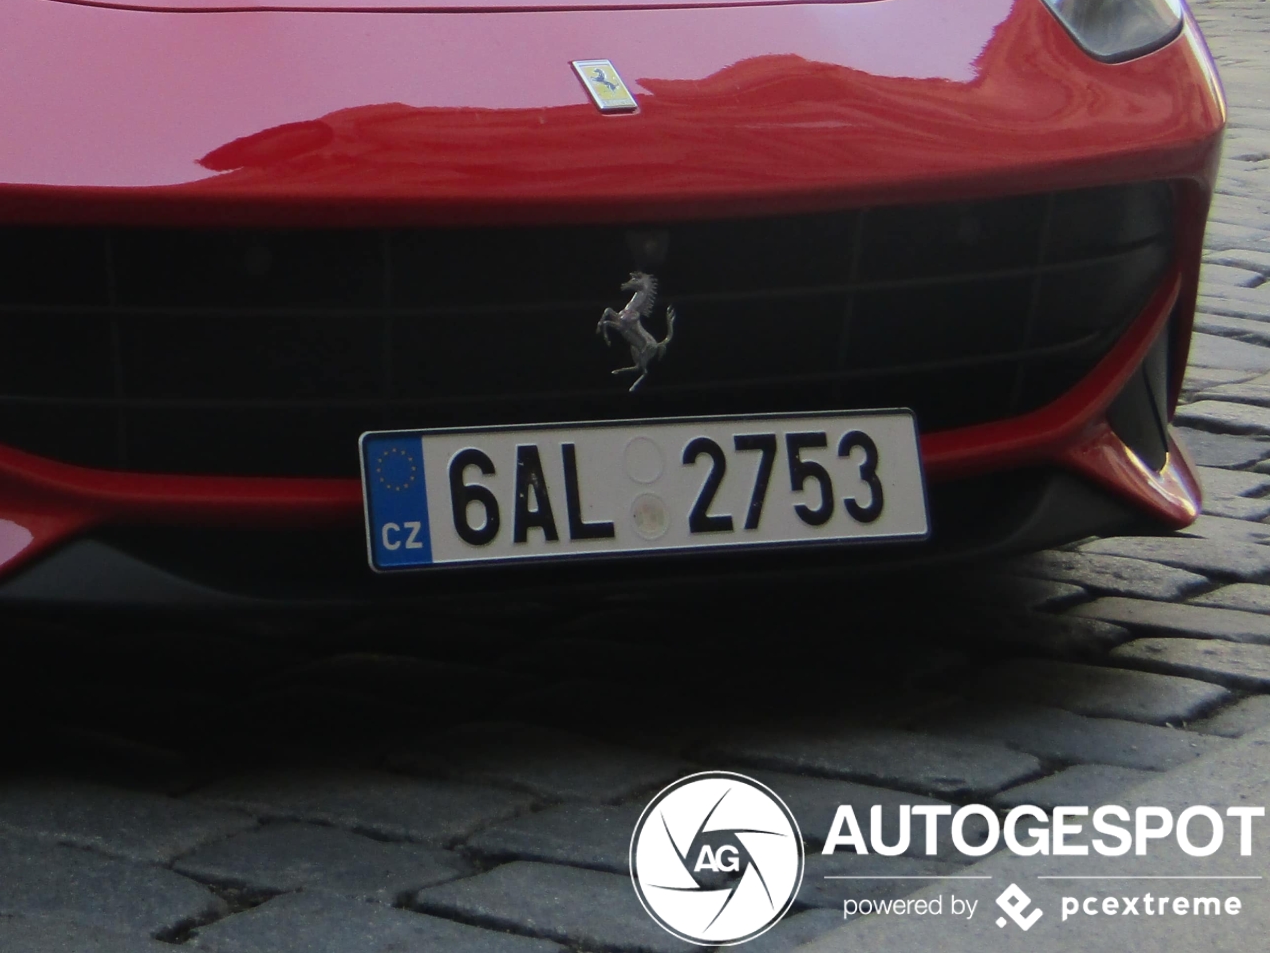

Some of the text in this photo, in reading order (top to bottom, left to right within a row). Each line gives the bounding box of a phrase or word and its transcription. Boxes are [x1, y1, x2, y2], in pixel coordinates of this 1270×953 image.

[448, 430, 884, 546] 6AL 2753
[382, 521, 423, 551] CZ
